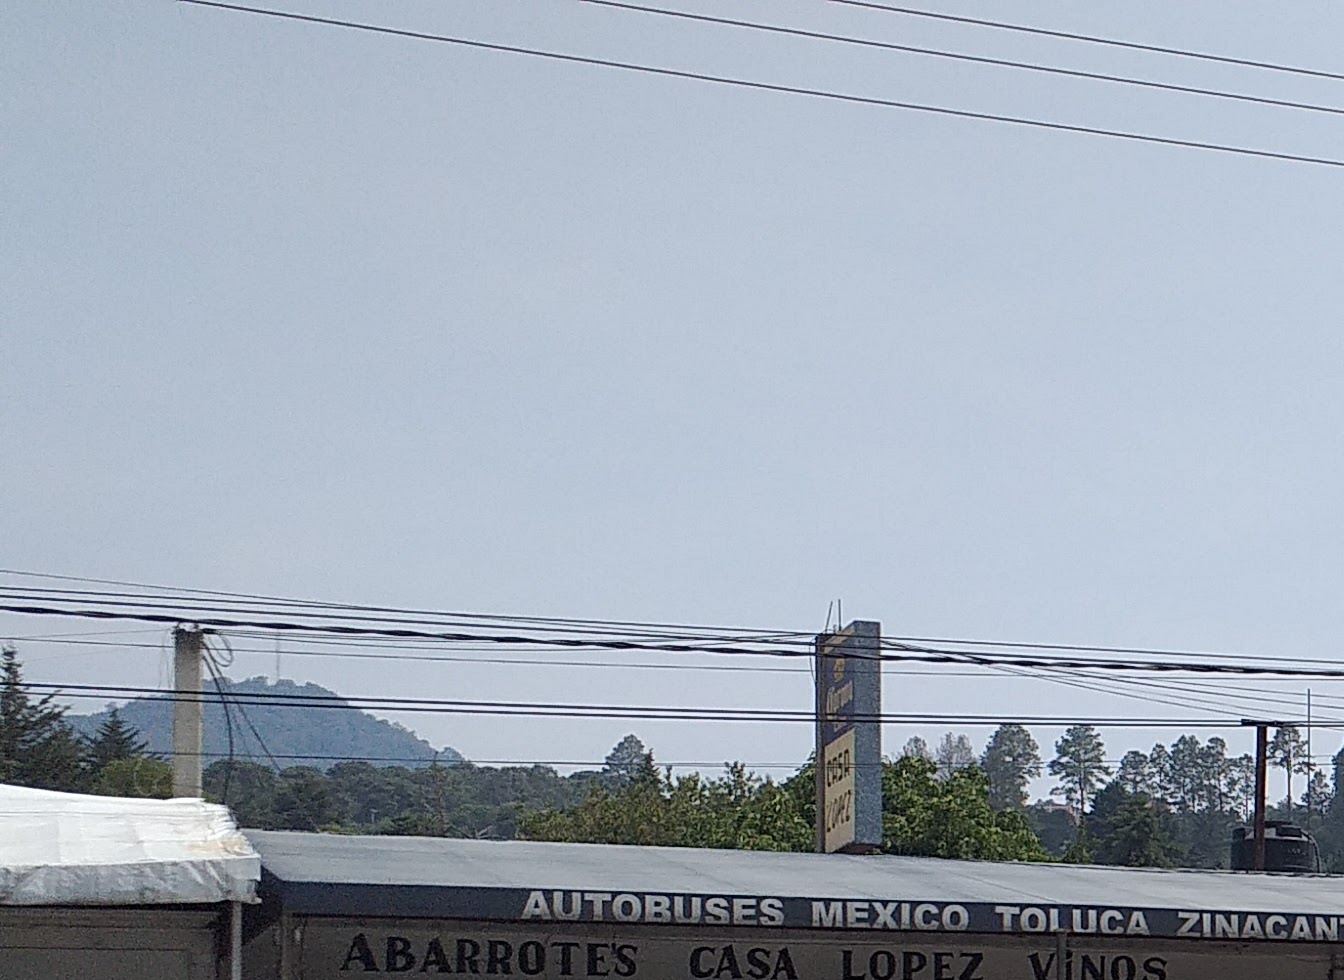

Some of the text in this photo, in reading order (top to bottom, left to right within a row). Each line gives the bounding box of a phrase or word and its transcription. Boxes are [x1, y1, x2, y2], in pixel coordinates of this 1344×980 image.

[827, 748, 850, 788] CASA
[520, 890, 786, 926] AUTOBUSES
[811, 901, 970, 932] MEXICO
[995, 905, 1150, 935] TOLUCA
[688, 944, 798, 980] CASA
